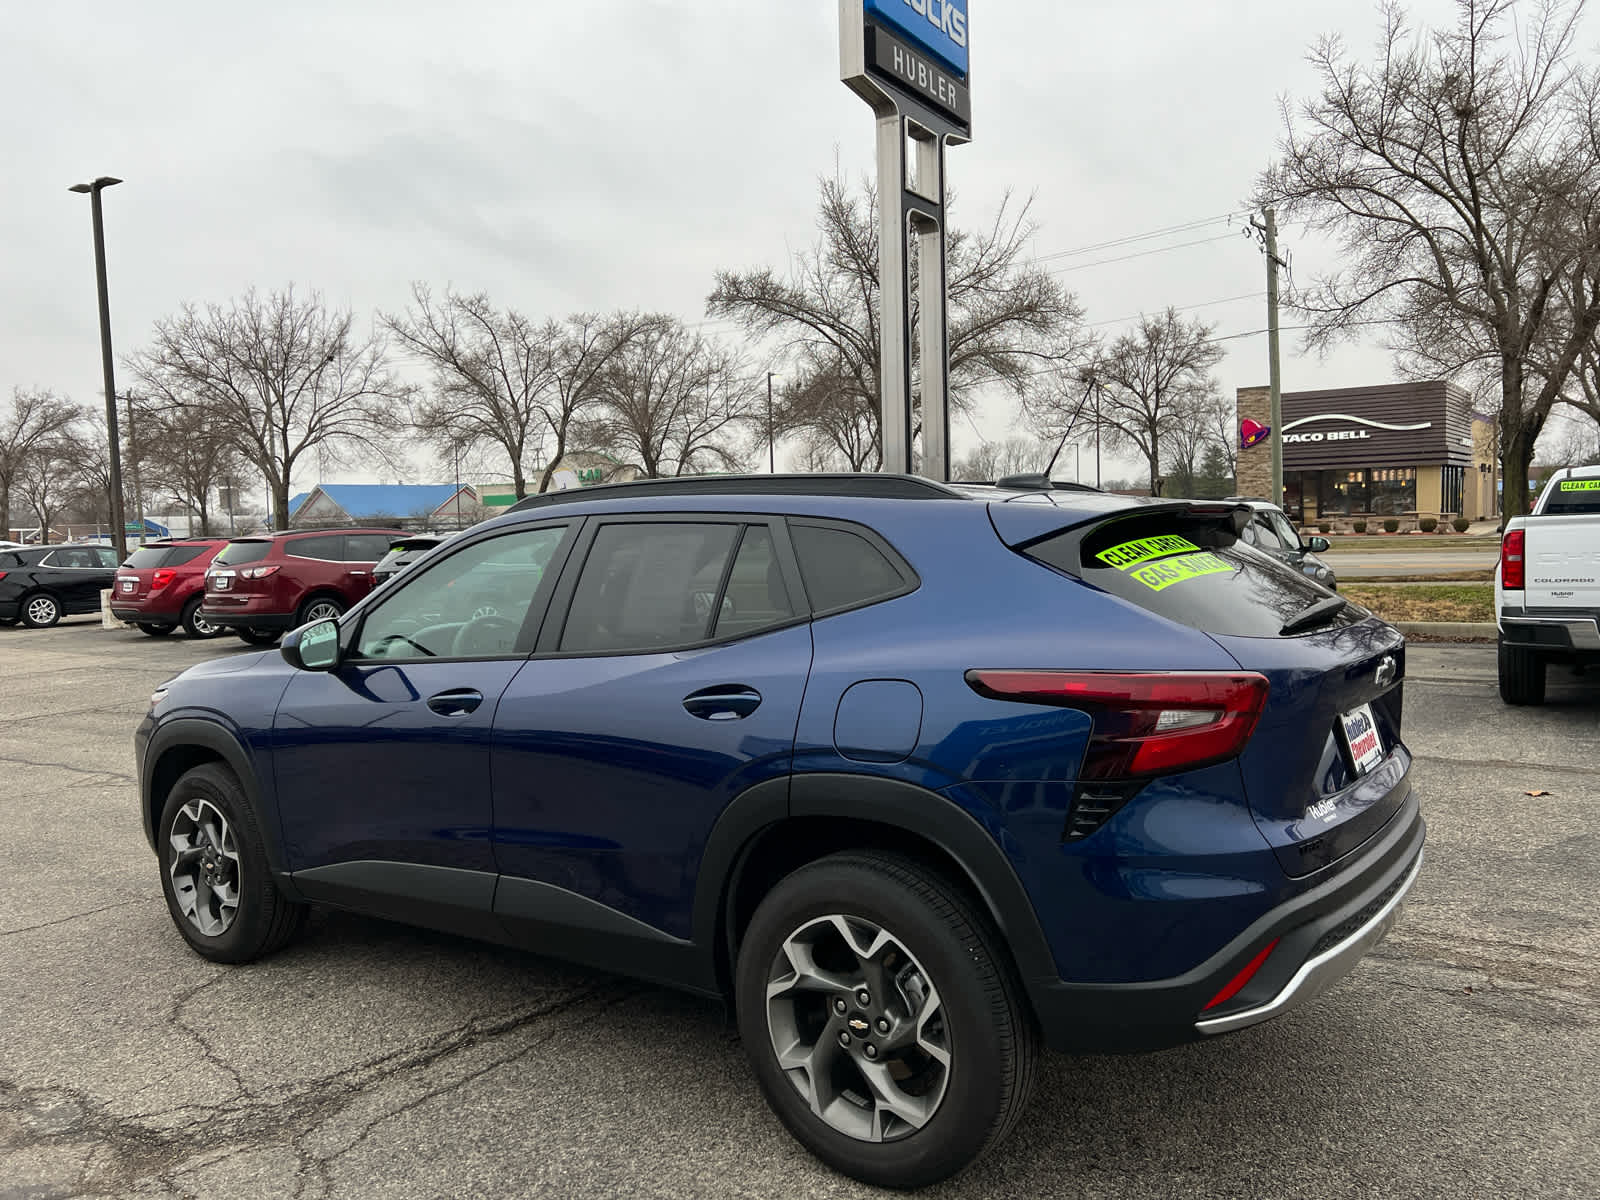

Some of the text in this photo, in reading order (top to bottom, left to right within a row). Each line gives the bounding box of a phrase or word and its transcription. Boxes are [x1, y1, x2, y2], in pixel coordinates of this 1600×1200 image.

[903, 0, 967, 48] CKS
[893, 45, 957, 109] HUBLER
[1281, 429, 1371, 443] TACO BELL
[1561, 482, 1586, 490] CLEAN
[1103, 541, 1153, 567] CLEAN
[1308, 798, 1337, 820] Hubler
